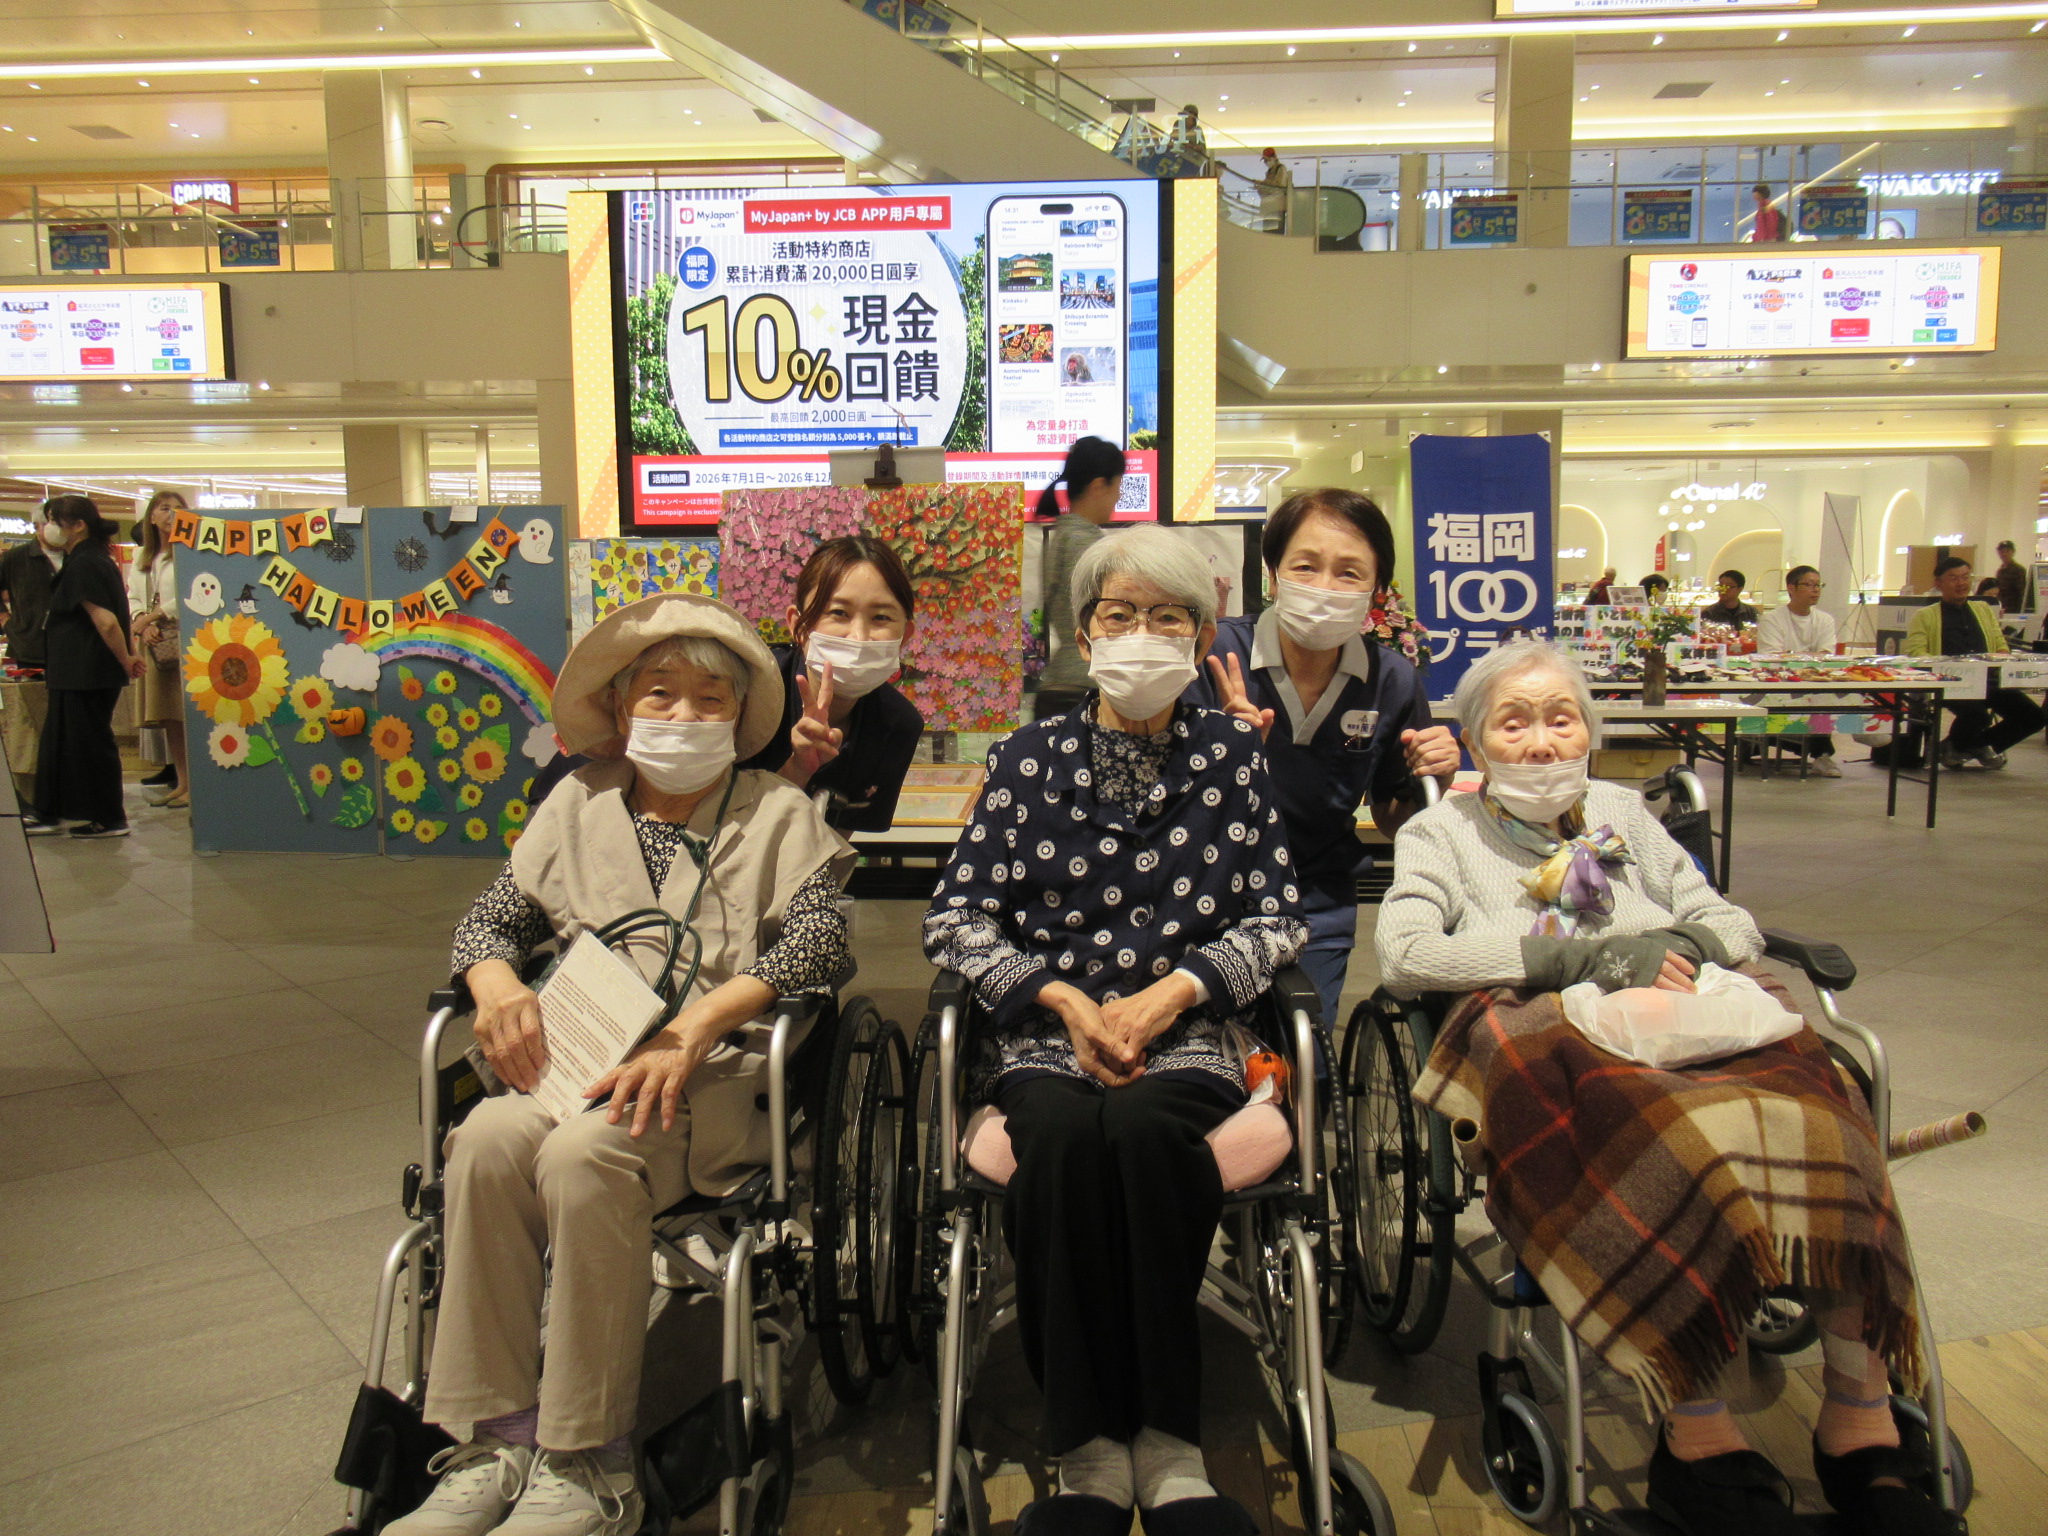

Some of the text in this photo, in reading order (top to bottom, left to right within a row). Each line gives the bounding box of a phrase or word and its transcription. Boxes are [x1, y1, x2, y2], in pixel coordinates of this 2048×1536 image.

[750, 211, 812, 225] MyJapan+
[815, 210, 830, 224] by
[833, 208, 857, 221] JCB
[772, 240, 871, 259] 活動特約商店
[686, 254, 709, 268] 福岡
[1937, 262, 1962, 271] MIFA
[686, 269, 709, 283] 限定
[843, 292, 939, 345] 現金
[682, 292, 843, 404] 10%
[846, 350, 941, 403] 回饋
[1026, 420, 1089, 431] 為您量身打造
[652, 473, 687, 484] 活動期間
[656, 509, 686, 517] campaign
[175, 519, 304, 548] HAPPY
[1427, 512, 1535, 563] 福岡
[270, 545, 499, 629] HALLOWEEN
[1429, 570, 1538, 622] 100
